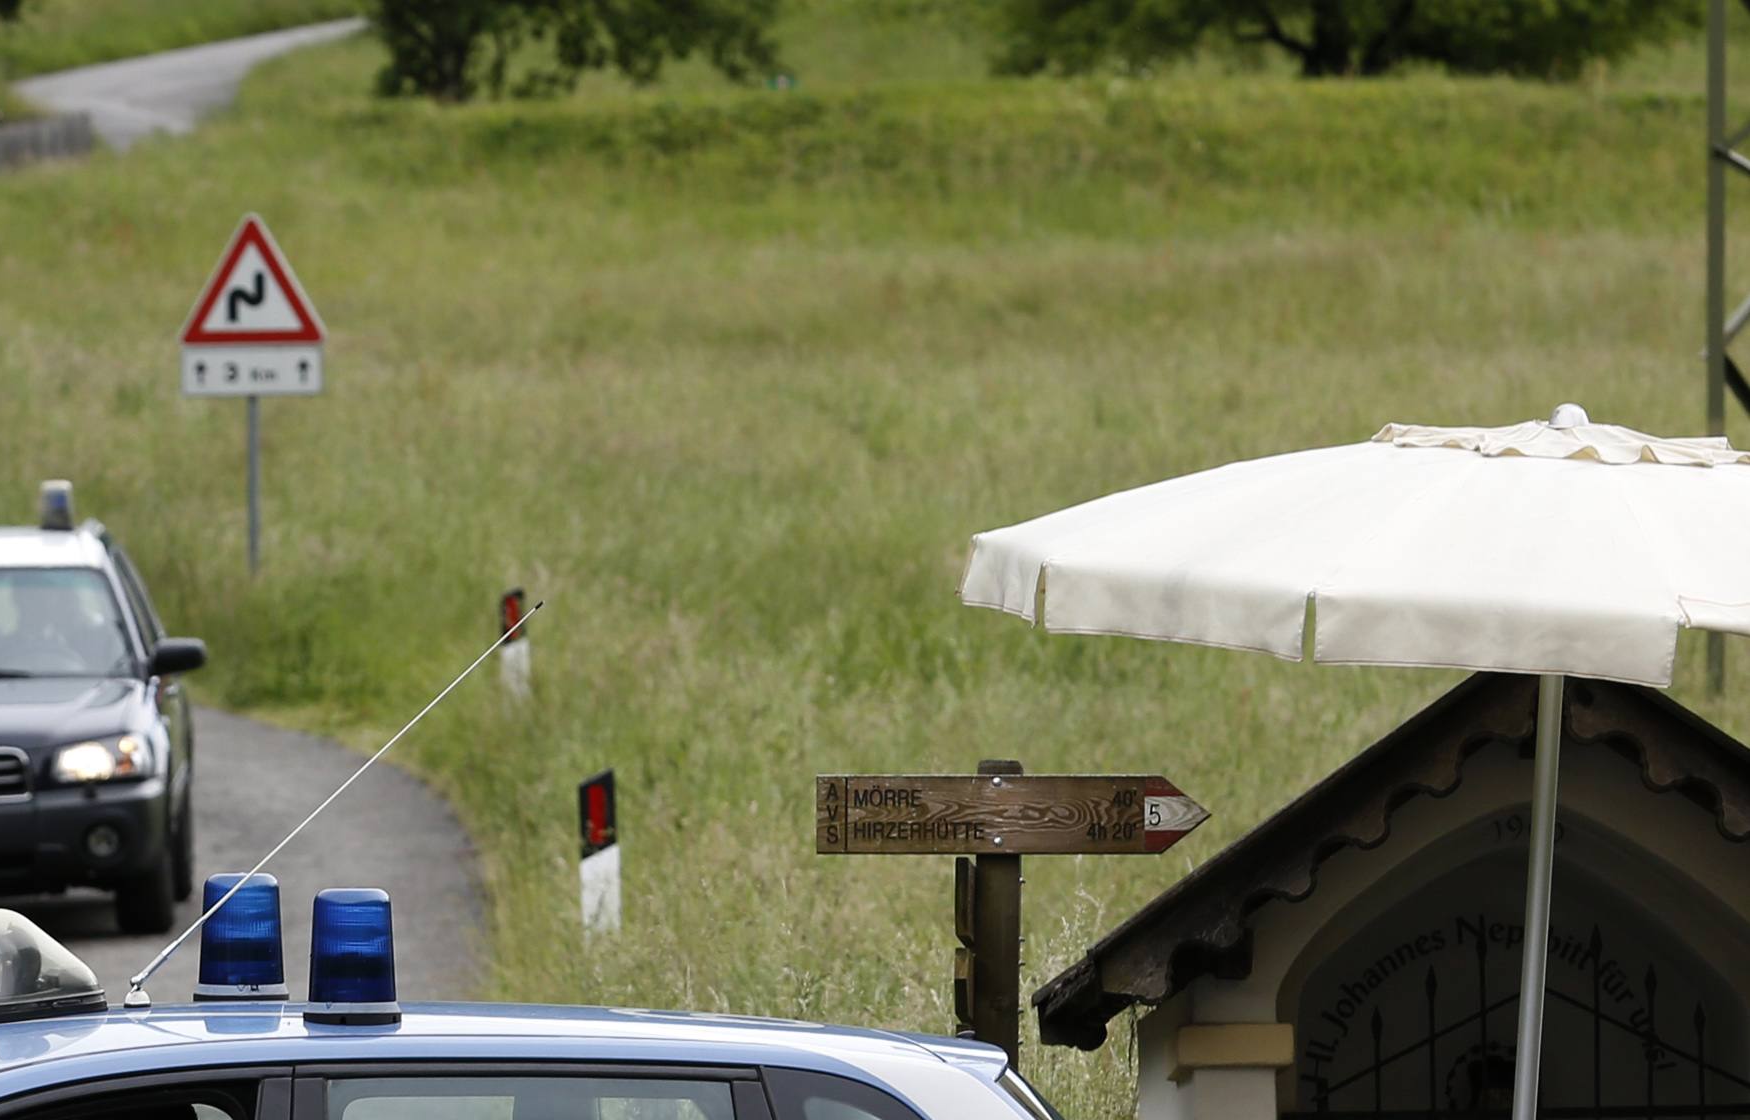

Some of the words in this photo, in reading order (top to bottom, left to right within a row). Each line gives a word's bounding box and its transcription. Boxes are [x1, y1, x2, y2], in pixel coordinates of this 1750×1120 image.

[853, 784, 923, 808] MÖRRE
[1149, 803, 1161, 827] 5
[853, 817, 985, 841] HIRZERHÜTTE
[1086, 822, 1107, 841] 4h
[1321, 928, 1447, 1039] Johannes
